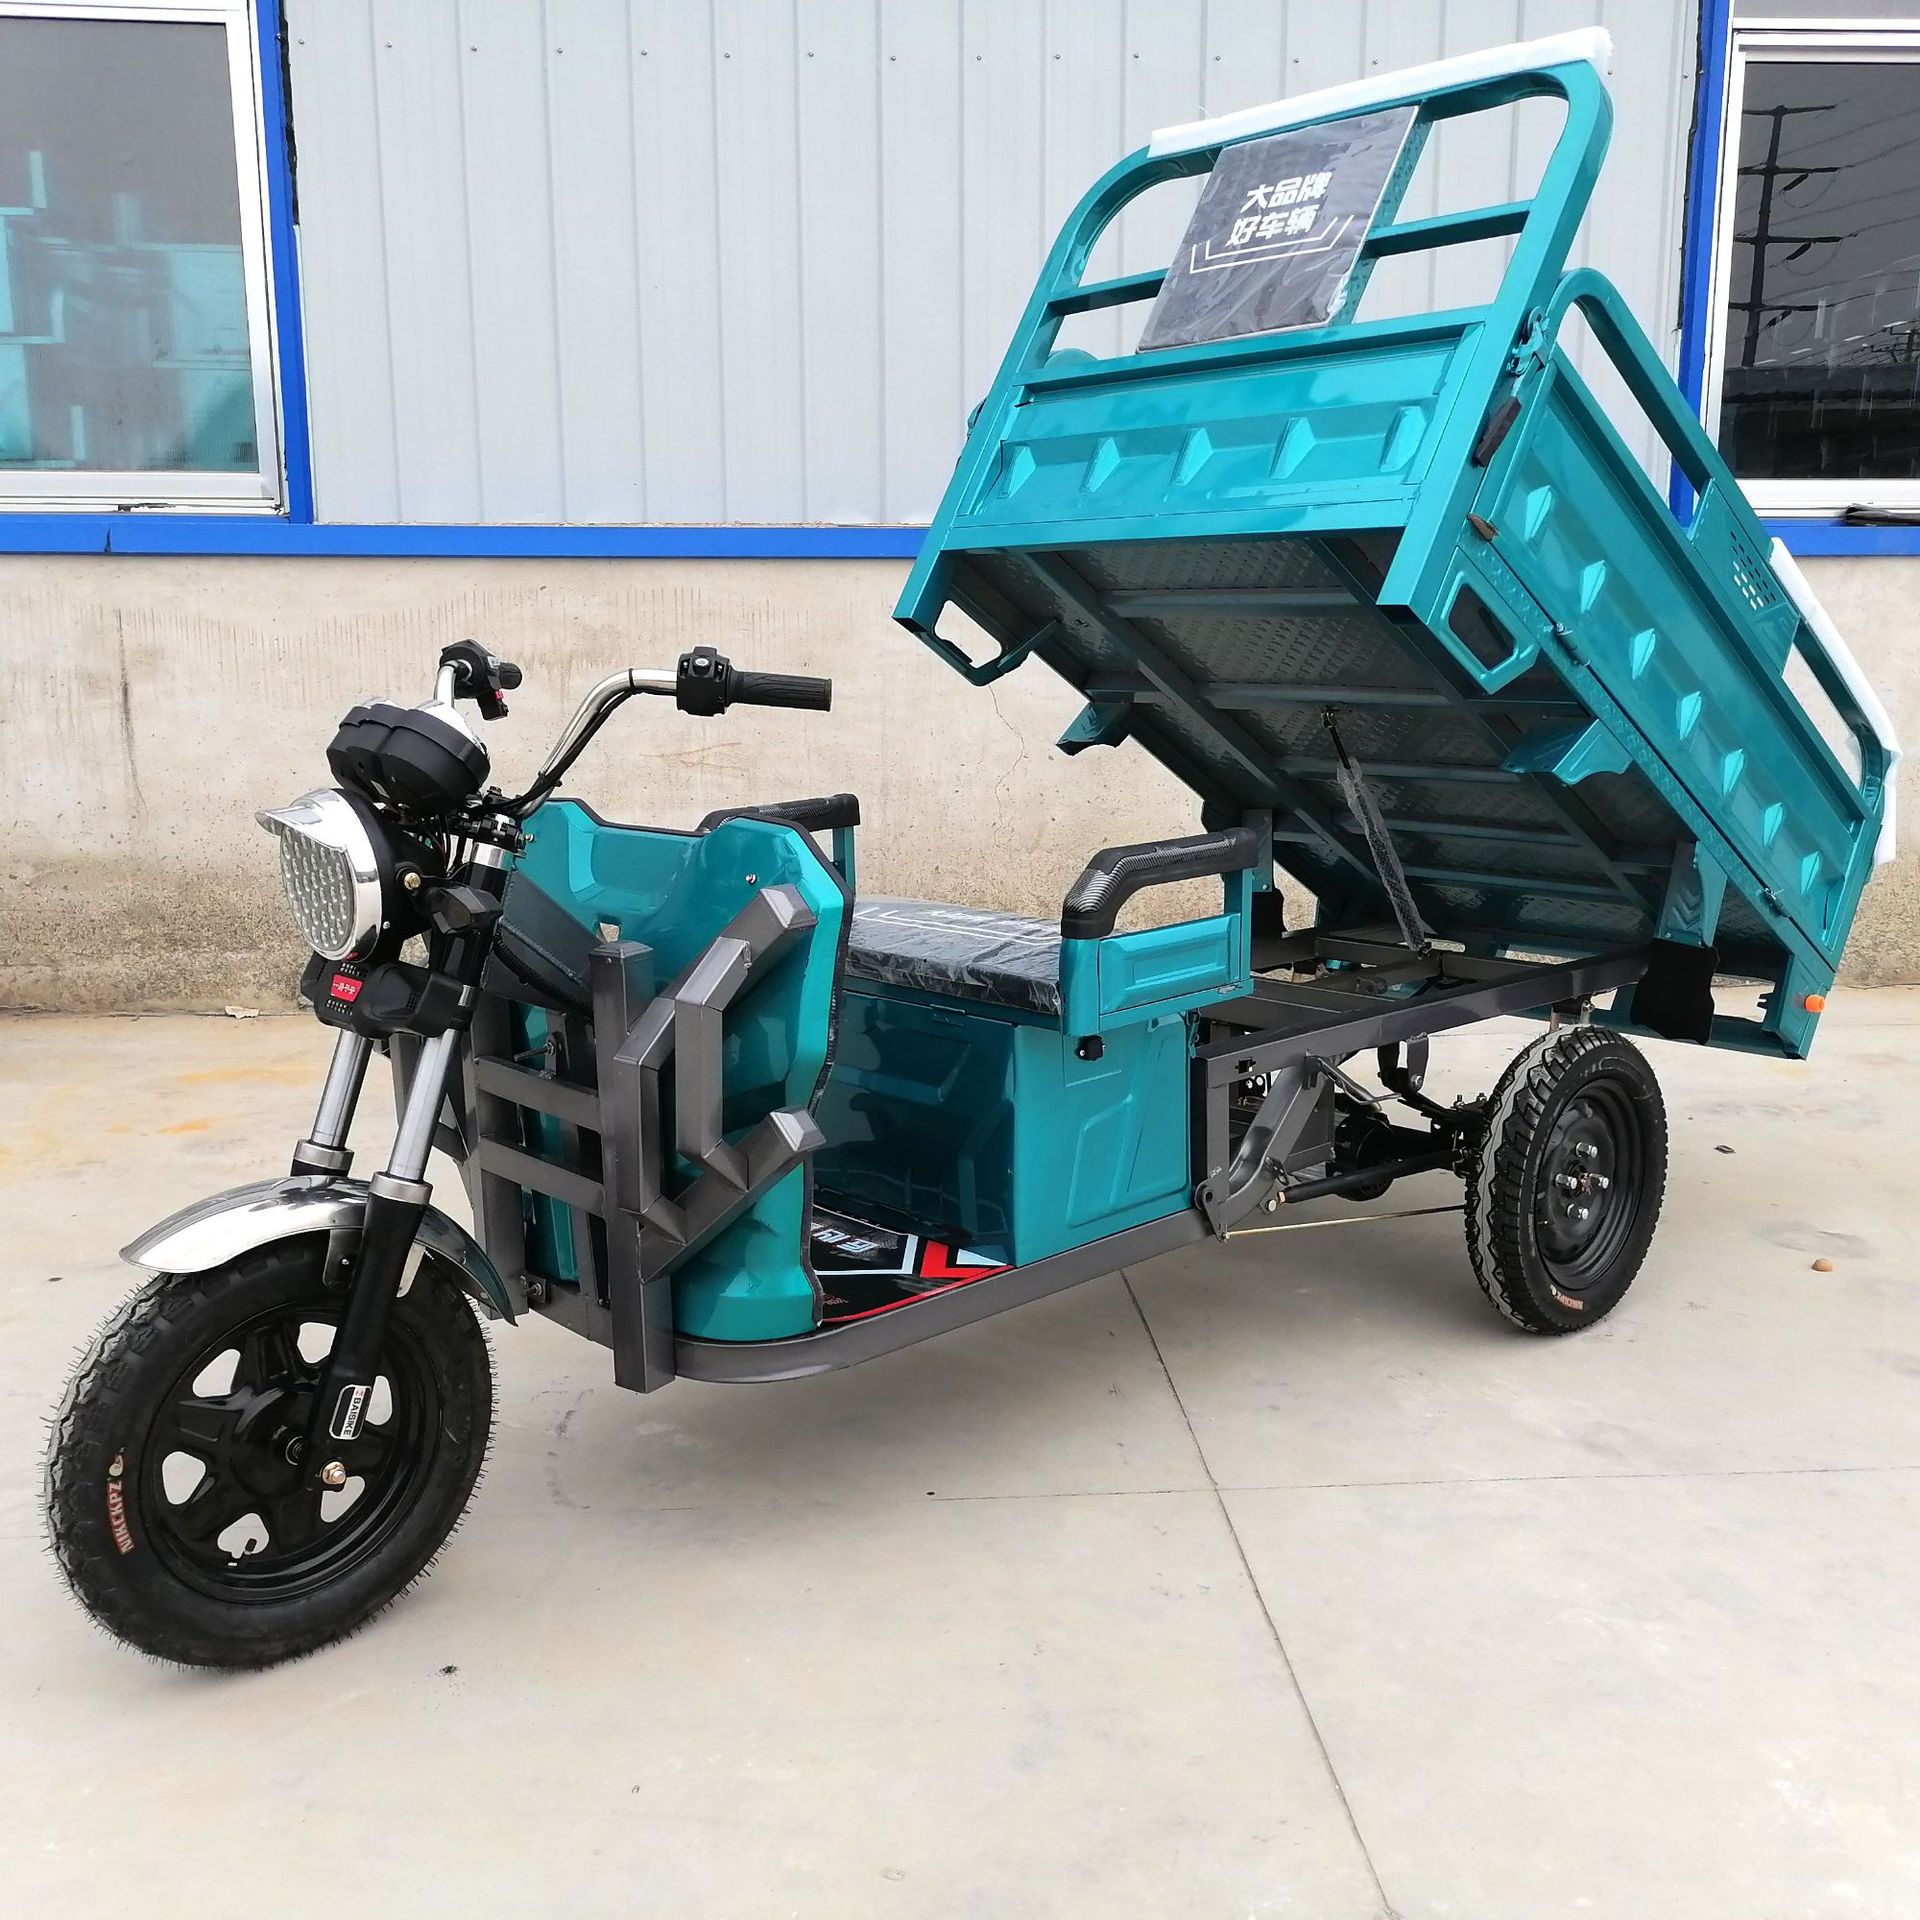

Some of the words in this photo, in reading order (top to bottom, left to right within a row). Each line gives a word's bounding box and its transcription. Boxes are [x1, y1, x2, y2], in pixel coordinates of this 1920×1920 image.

[1240, 171, 1333, 212] 大品牌
[1225, 205, 1320, 246] 好车辆
